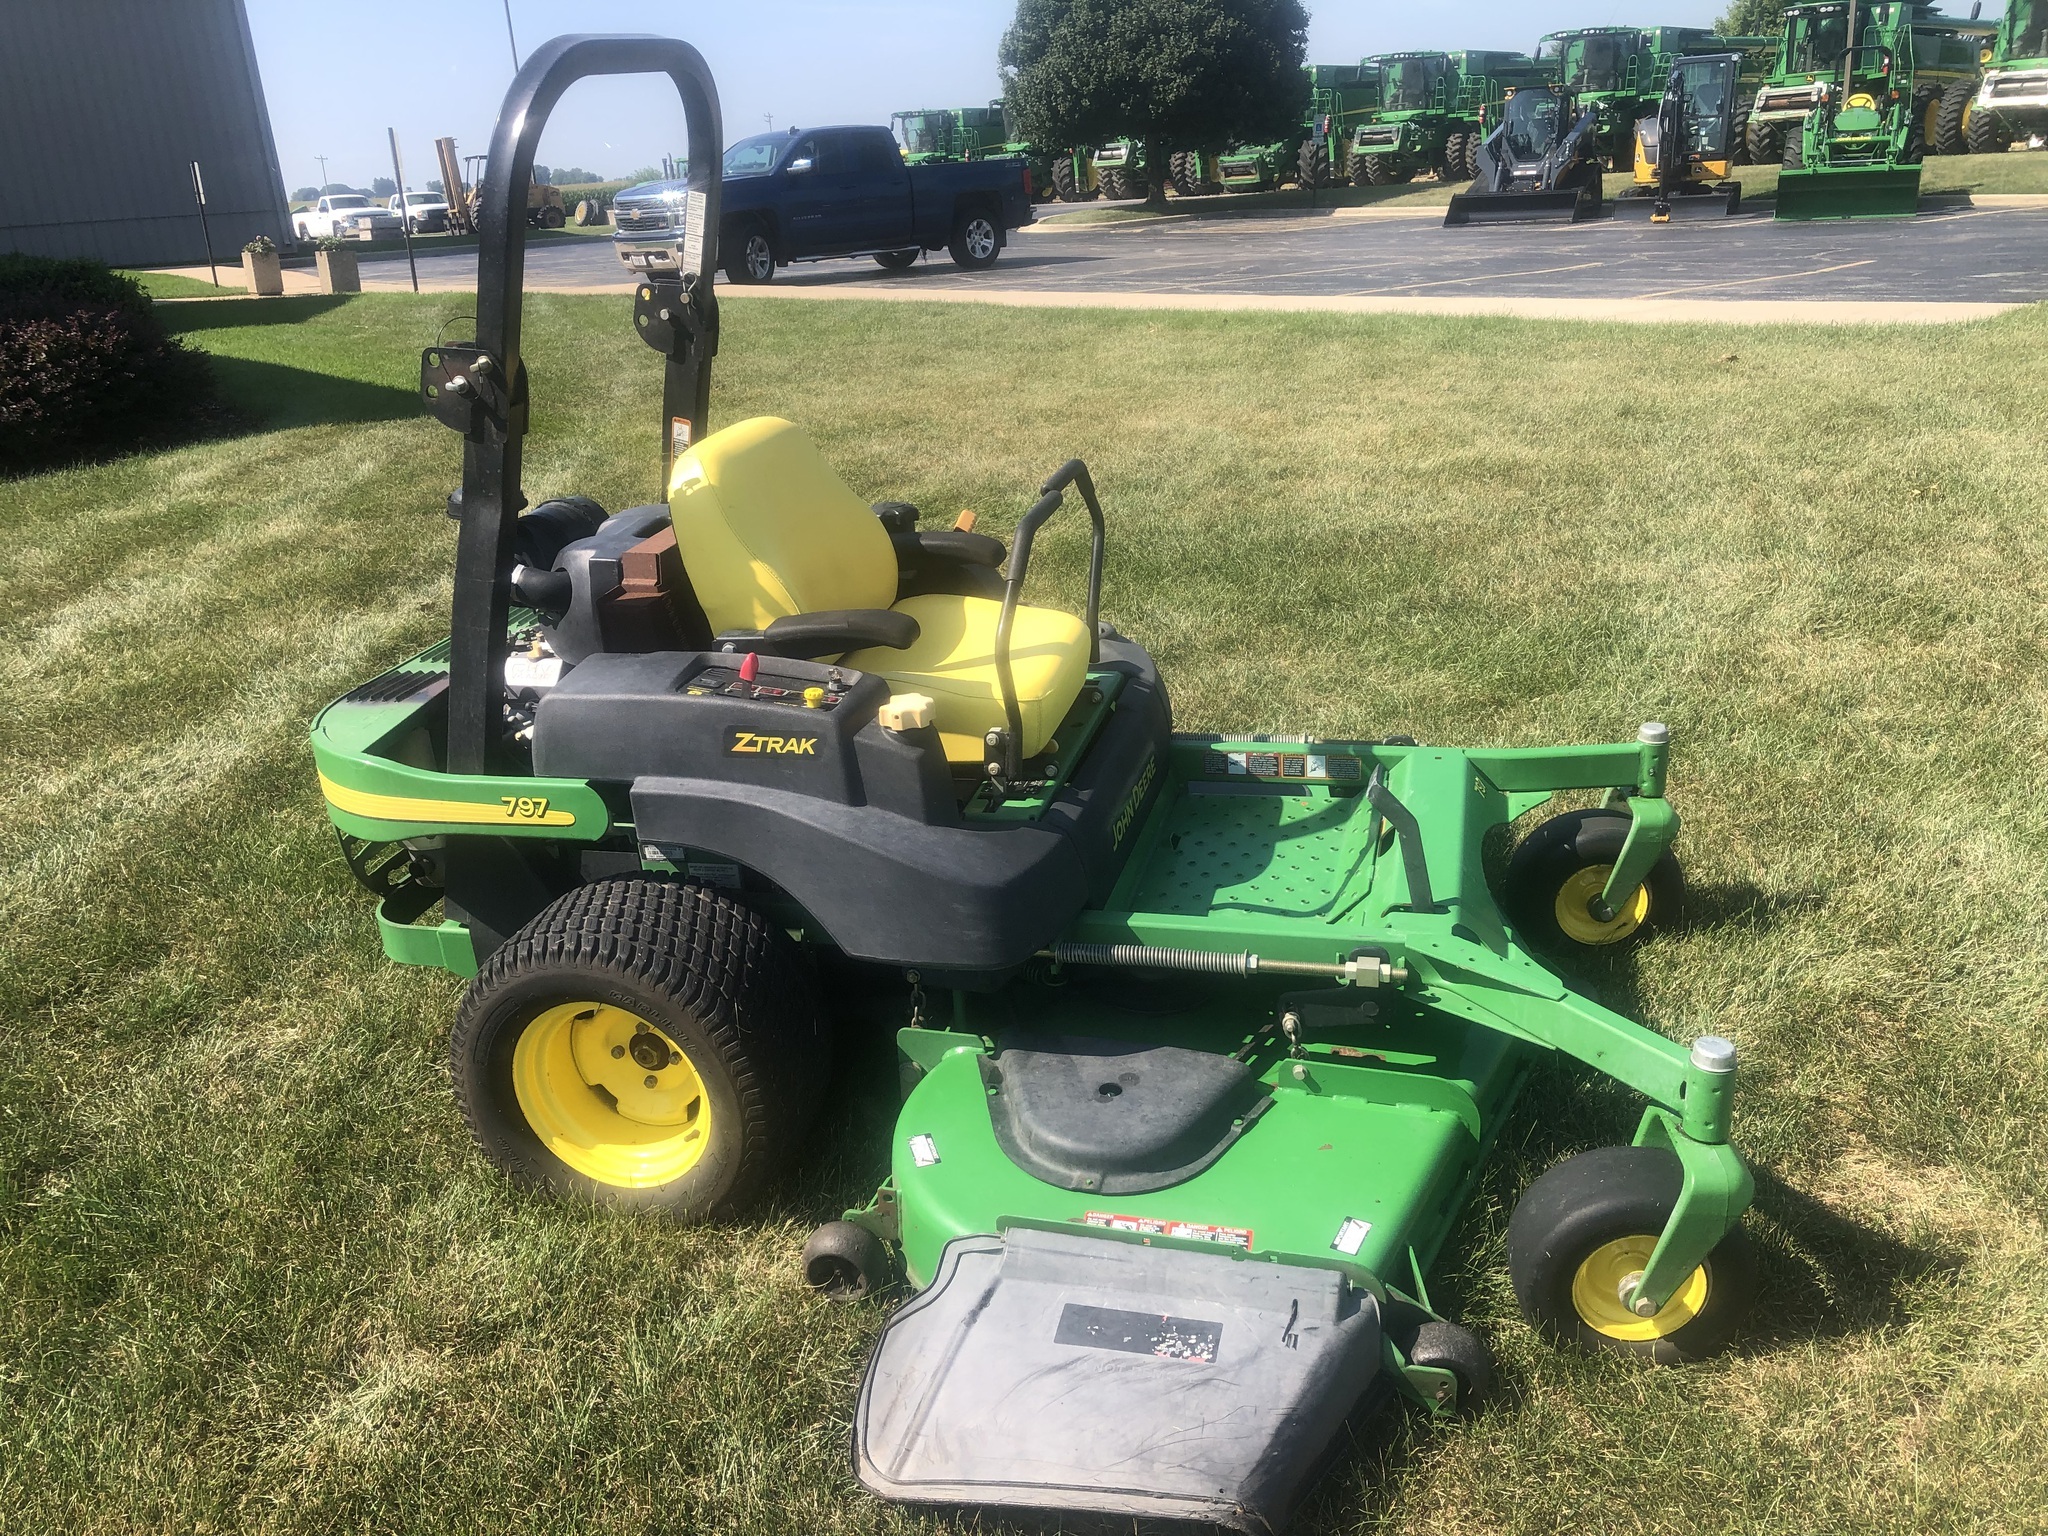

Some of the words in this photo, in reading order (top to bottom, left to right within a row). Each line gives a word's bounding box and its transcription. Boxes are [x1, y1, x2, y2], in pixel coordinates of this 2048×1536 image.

[731, 732, 818, 756] ZTRAK
[501, 796, 550, 818] 797
[1112, 799, 1134, 852] JOHN
[1132, 755, 1157, 810] DEERE
[1091, 1212, 1115, 1220] DANGER
[1143, 1218, 1167, 1226] PELIGRO
[1186, 1223, 1209, 1231] DANGER
[1223, 1227, 1248, 1235] PELIGRO
